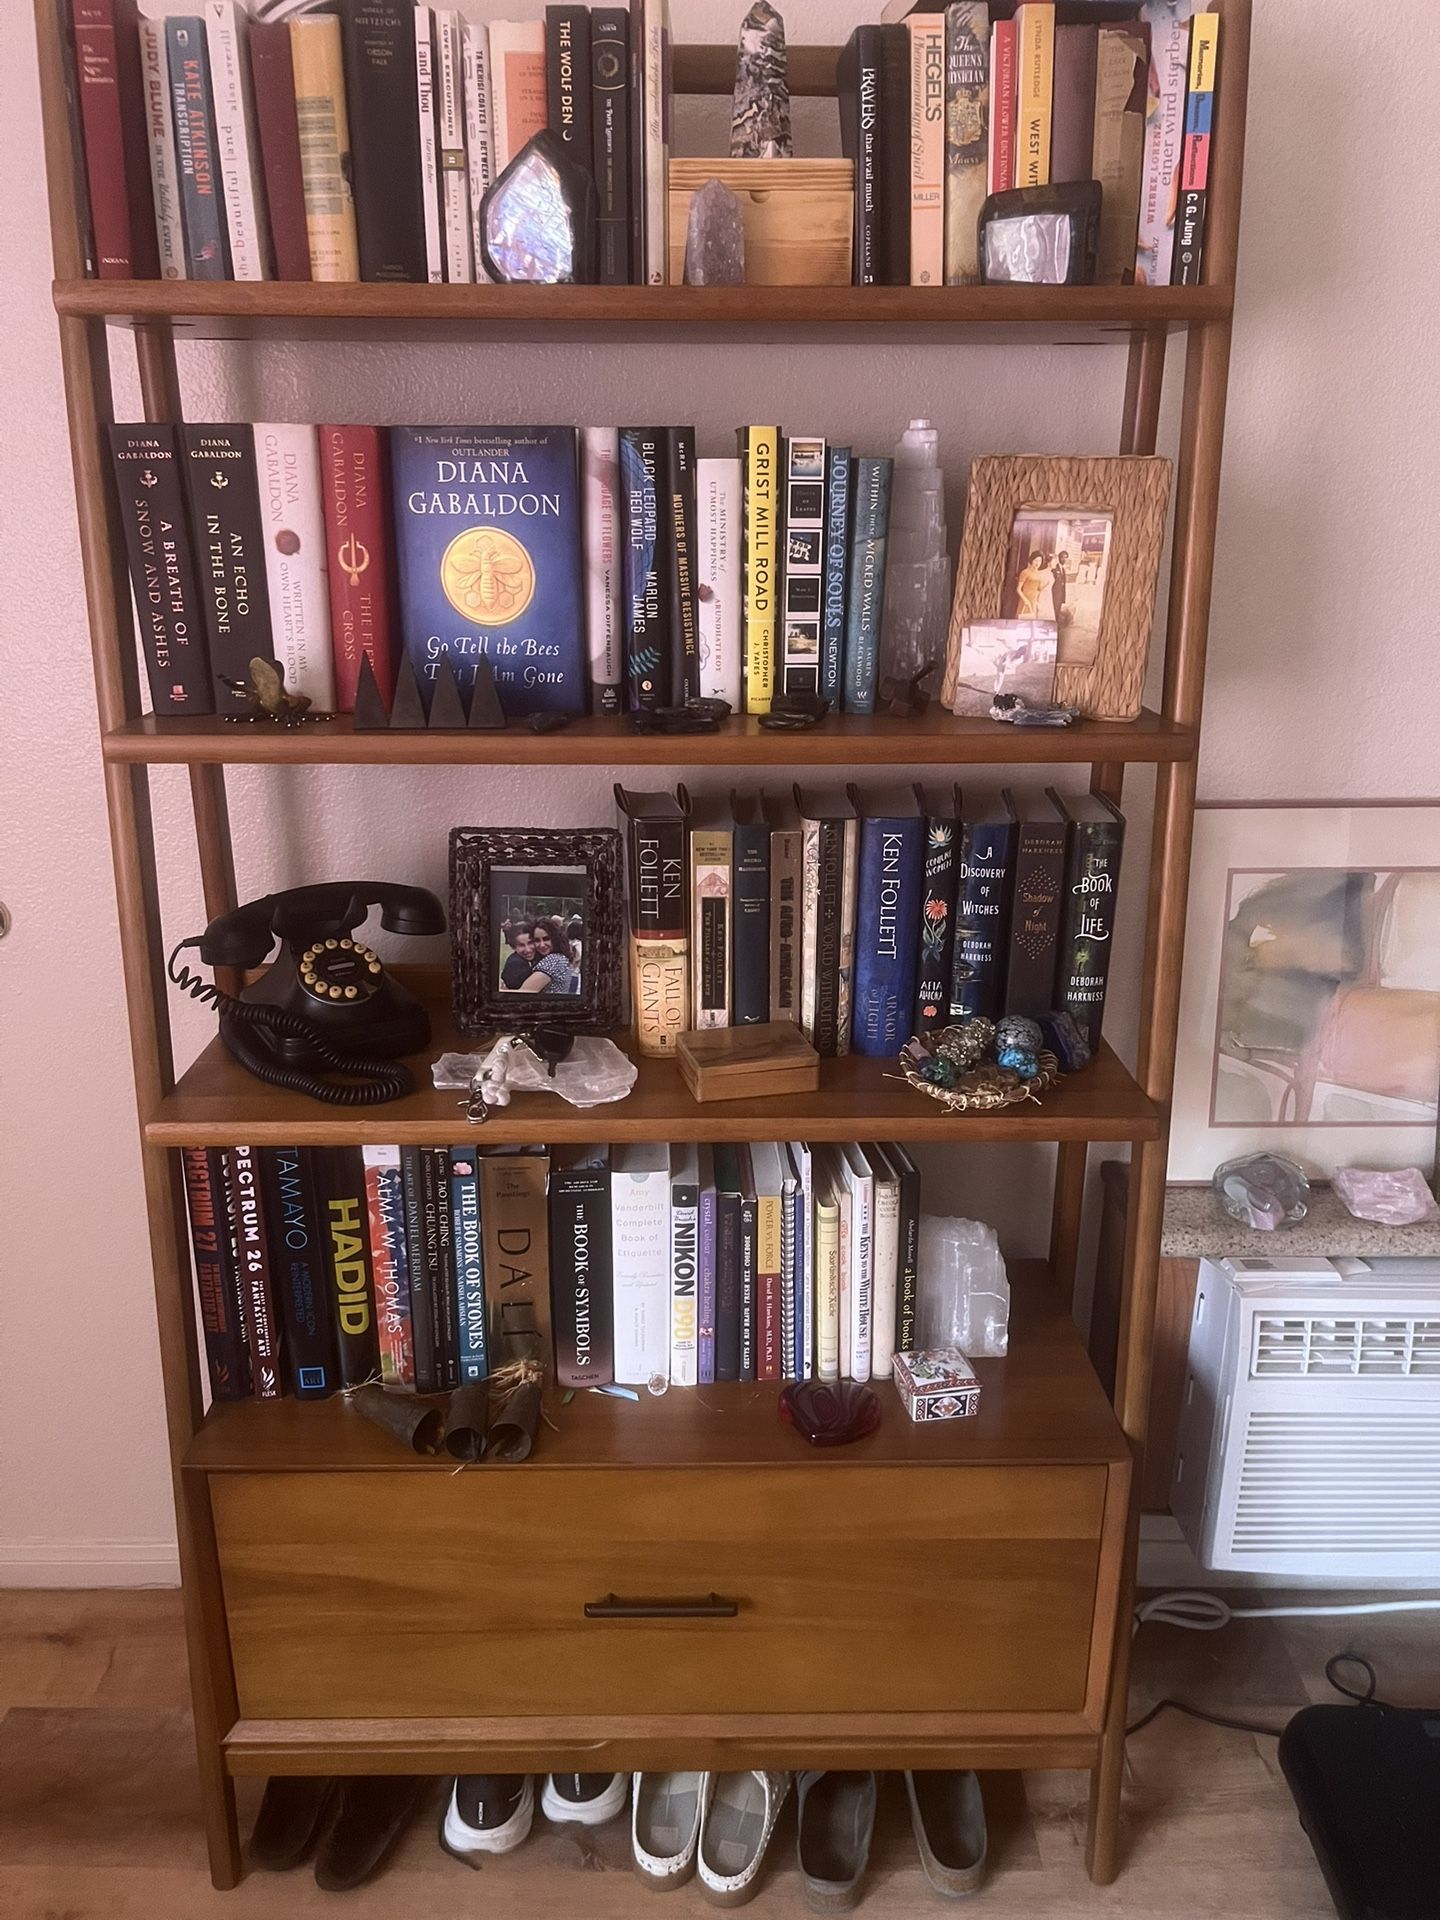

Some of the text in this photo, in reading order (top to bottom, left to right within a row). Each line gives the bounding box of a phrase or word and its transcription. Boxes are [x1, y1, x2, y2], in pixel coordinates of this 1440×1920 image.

[418, 51, 431, 78] and
[559, 21, 573, 124] THE WOLF DEN
[925, 34, 942, 122] HEGEL'S
[1033, 20, 1042, 98] LYNDA RUTLEDGE
[144, 26, 165, 138] JUDY BLUME
[420, 79, 432, 113] Thou
[444, 64, 454, 137] EXECUTIONER
[1161, 20, 1182, 187] einer wird sterben
[174, 82, 194, 175] TRANSCRIPTION
[183, 60, 213, 195] KATE ATKINSON
[860, 67, 877, 212] PRAYERS that avail much
[1147, 122, 1161, 224] WIEBKE LORENZ
[117, 451, 172, 460] GABALDON
[127, 440, 160, 448] DIANA
[190, 450, 242, 459] GABALDON
[200, 439, 231, 447] DIANA
[451, 448, 510, 457] OUTLANDER
[678, 442, 686, 471] McRAE
[265, 434, 283, 522] GABALDON
[283, 453, 299, 504] DIANA
[331, 432, 348, 527] GABALDON
[353, 452, 367, 508] DIANA
[436, 461, 530, 483] DIANA
[642, 442, 657, 541] BLACK LEOPARD
[408, 491, 561, 517] GABALDON
[630, 490, 644, 550] RED WOLF
[755, 442, 770, 611] GRIST MILL ROAD
[827, 455, 848, 628] JOURNEY OF SOULS
[135, 499, 170, 668] SNOW AND ASHES
[160, 520, 189, 646] A BREATH OF
[207, 514, 231, 633] IN THE BONE
[230, 532, 250, 616] AN ECHO
[645, 570, 659, 618] MARLON
[672, 494, 695, 656] MOTHERS OF MASSIVE RESISTANCE
[633, 594, 646, 633] JAMES
[714, 598, 722, 655] ARUNDHATI
[343, 610, 356, 661] CROSS
[427, 636, 560, 660] Go Tell the Bees
[827, 637, 838, 688] NEWTON
[855, 636, 865, 687] BLACKWOOD
[865, 646, 873, 677] LAUREN
[639, 839, 660, 919] FOLLETT
[662, 858, 682, 898] KEN
[960, 863, 1006, 879] DISCOVERY
[980, 885, 991, 898] OF
[1073, 875, 1113, 895] BOOK
[877, 833, 903, 960] KEN FOLLETT
[962, 900, 1000, 916] WITCHES
[1089, 897, 1101, 911] OF
[962, 940, 992, 949] DEBORAH
[1076, 914, 1110, 940] LIFE
[716, 923, 725, 985] KEN FOLLETT
[960, 952, 992, 962] HARKNESS
[641, 962, 661, 1033] GIANTS
[665, 966, 683, 1029] FALL OF
[1067, 990, 1104, 1002] HARKNESS
[1070, 975, 1104, 987] DEBORAH
[405, 1155, 413, 1170] THE
[235, 1146, 260, 1242] PECTRUM
[276, 1146, 308, 1250] TAMAYO
[376, 1175, 397, 1225] ALMA
[407, 1187, 414, 1197] OF
[437, 1178, 448, 1199] TAO
[438, 1201, 448, 1213] TE
[461, 1182, 477, 1216] THE
[615, 1203, 664, 1211] Vanderbilt
[629, 1188, 650, 1198] Amy
[408, 1200, 418, 1243] DANIEL
[439, 1214, 450, 1247] CHING
[463, 1220, 480, 1265] BOOK
[616, 1219, 663, 1228] Complete
[246, 1249, 263, 1272] 26
[328, 1197, 370, 1335] HADID
[410, 1245, 422, 1292] MERRIAM
[617, 1249, 662, 1258] Etiquette
[674, 1222, 696, 1297] NIKON
[743, 1235, 751, 1267] COOKBOOK
[382, 1258, 402, 1334] THOMAS
[465, 1267, 481, 1288] OF
[574, 1203, 591, 1366] THE BOOK OF SYMBOLS
[743, 1283, 751, 1304] FRESH
[903, 1275, 915, 1301] book
[251, 1280, 268, 1358] FANTASTIC ART
[466, 1292, 484, 1350] STONES
[673, 1298, 694, 1340] D90
[743, 1307, 751, 1324] BRAVO
[903, 1304, 914, 1315] of
[743, 1326, 751, 1339] RIO
[902, 1318, 914, 1350] books
[570, 1373, 600, 1381] TASCHEN
[743, 1347, 751, 1369] CHEVYS
